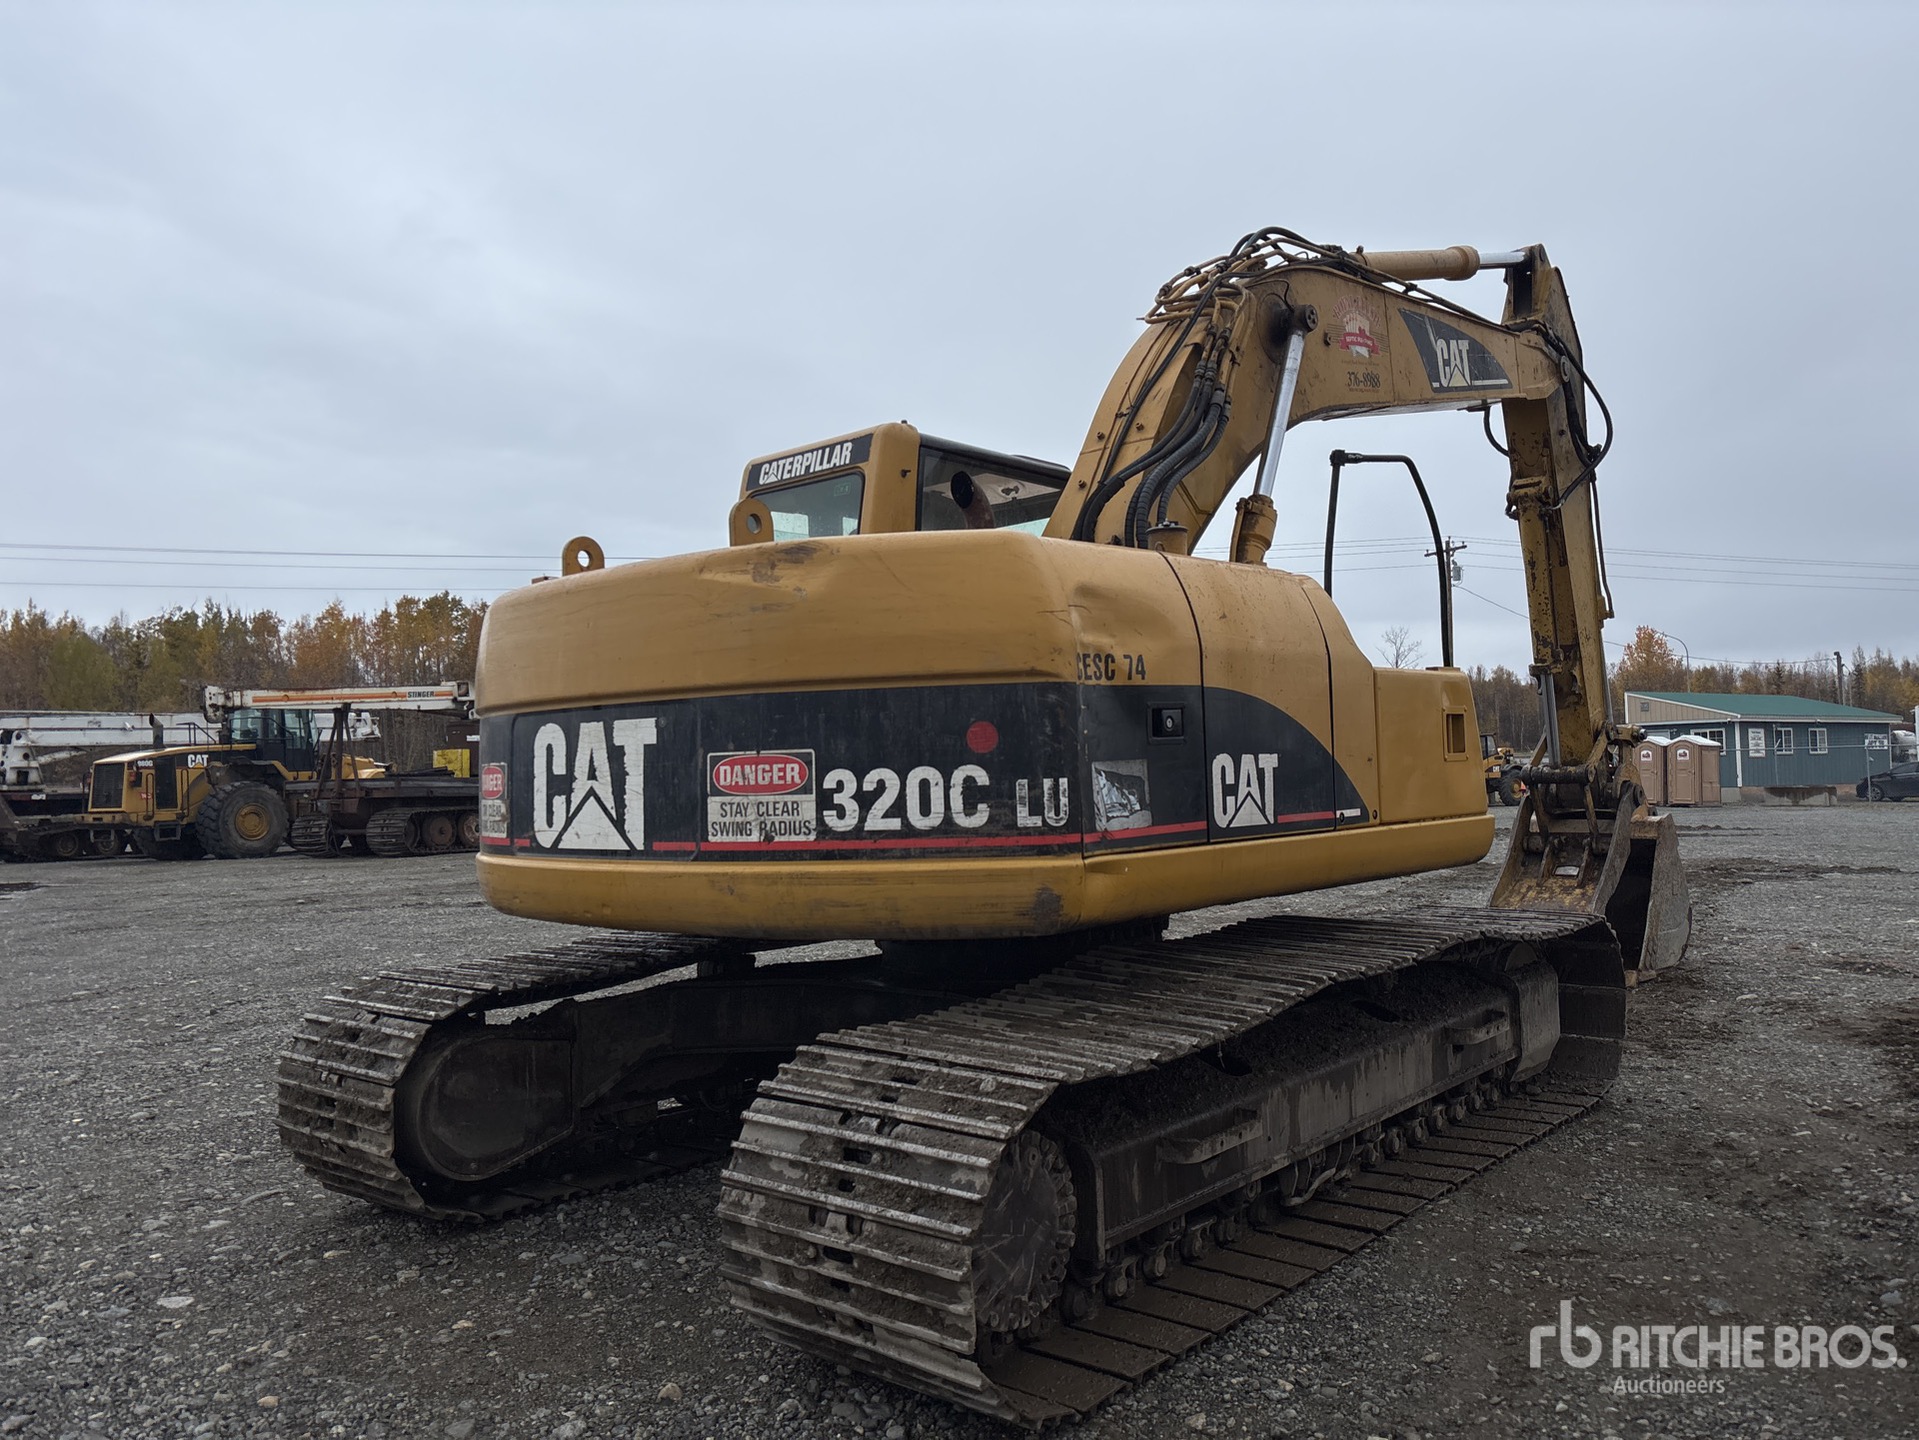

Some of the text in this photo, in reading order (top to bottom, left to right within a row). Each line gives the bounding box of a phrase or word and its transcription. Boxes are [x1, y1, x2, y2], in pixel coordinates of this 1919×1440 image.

[1436, 339, 1471, 387] CAT
[758, 441, 853, 485] CATERPILLAR
[1123, 653, 1147, 680] 74
[407, 691, 435, 699] STINGER
[187, 754, 209, 768] CAT
[719, 763, 803, 786] DANGER
[533, 717, 658, 851] CAT
[1212, 753, 1278, 829] CAT
[720, 801, 801, 818] STAY CLEAR
[822, 764, 1069, 832] 320C LU
[711, 819, 812, 837] SWING RADIUS
